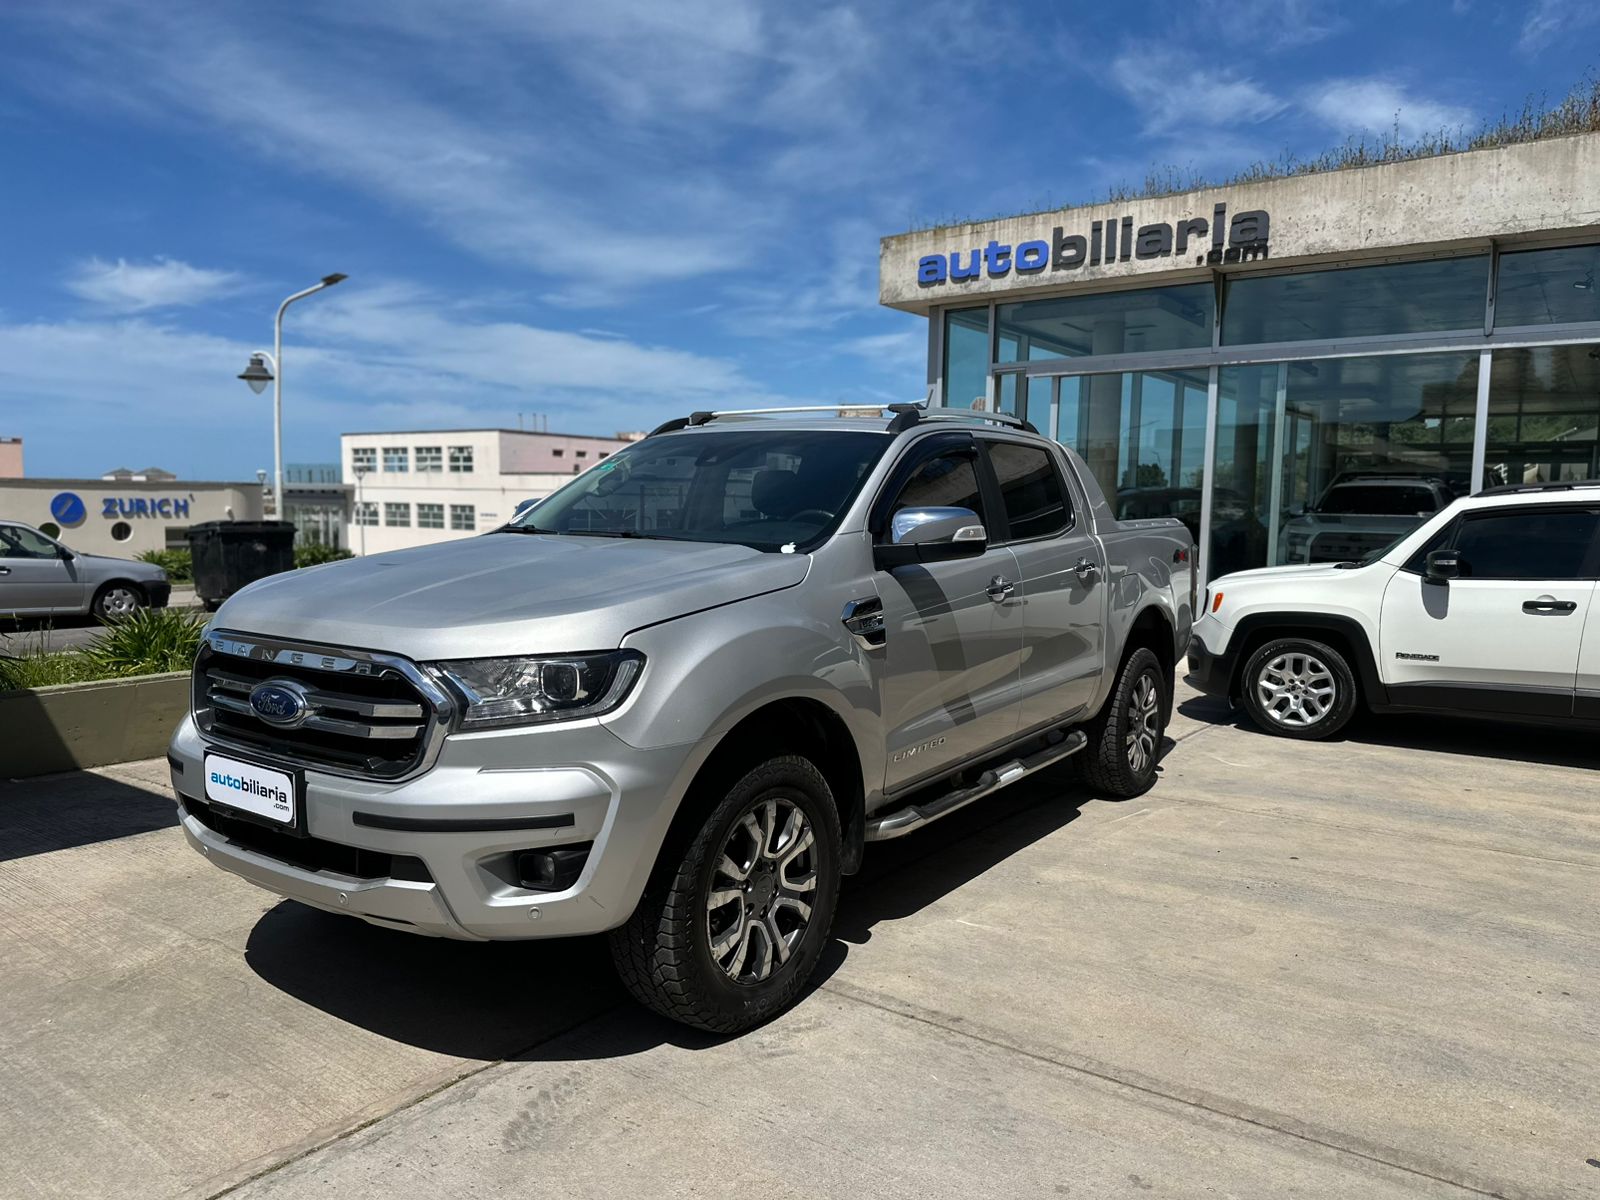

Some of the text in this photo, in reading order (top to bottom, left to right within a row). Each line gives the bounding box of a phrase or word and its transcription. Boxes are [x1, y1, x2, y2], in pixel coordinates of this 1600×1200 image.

[917, 202, 1270, 286] autobiliaria
[1197, 245, 1268, 265] .com
[102, 498, 190, 518] ZURICH
[214, 640, 373, 675] RANGER
[257, 691, 287, 715] Ford
[893, 736, 946, 763] LIMITED
[211, 771, 287, 803] autobiliaria
[273, 802, 290, 812] .com
